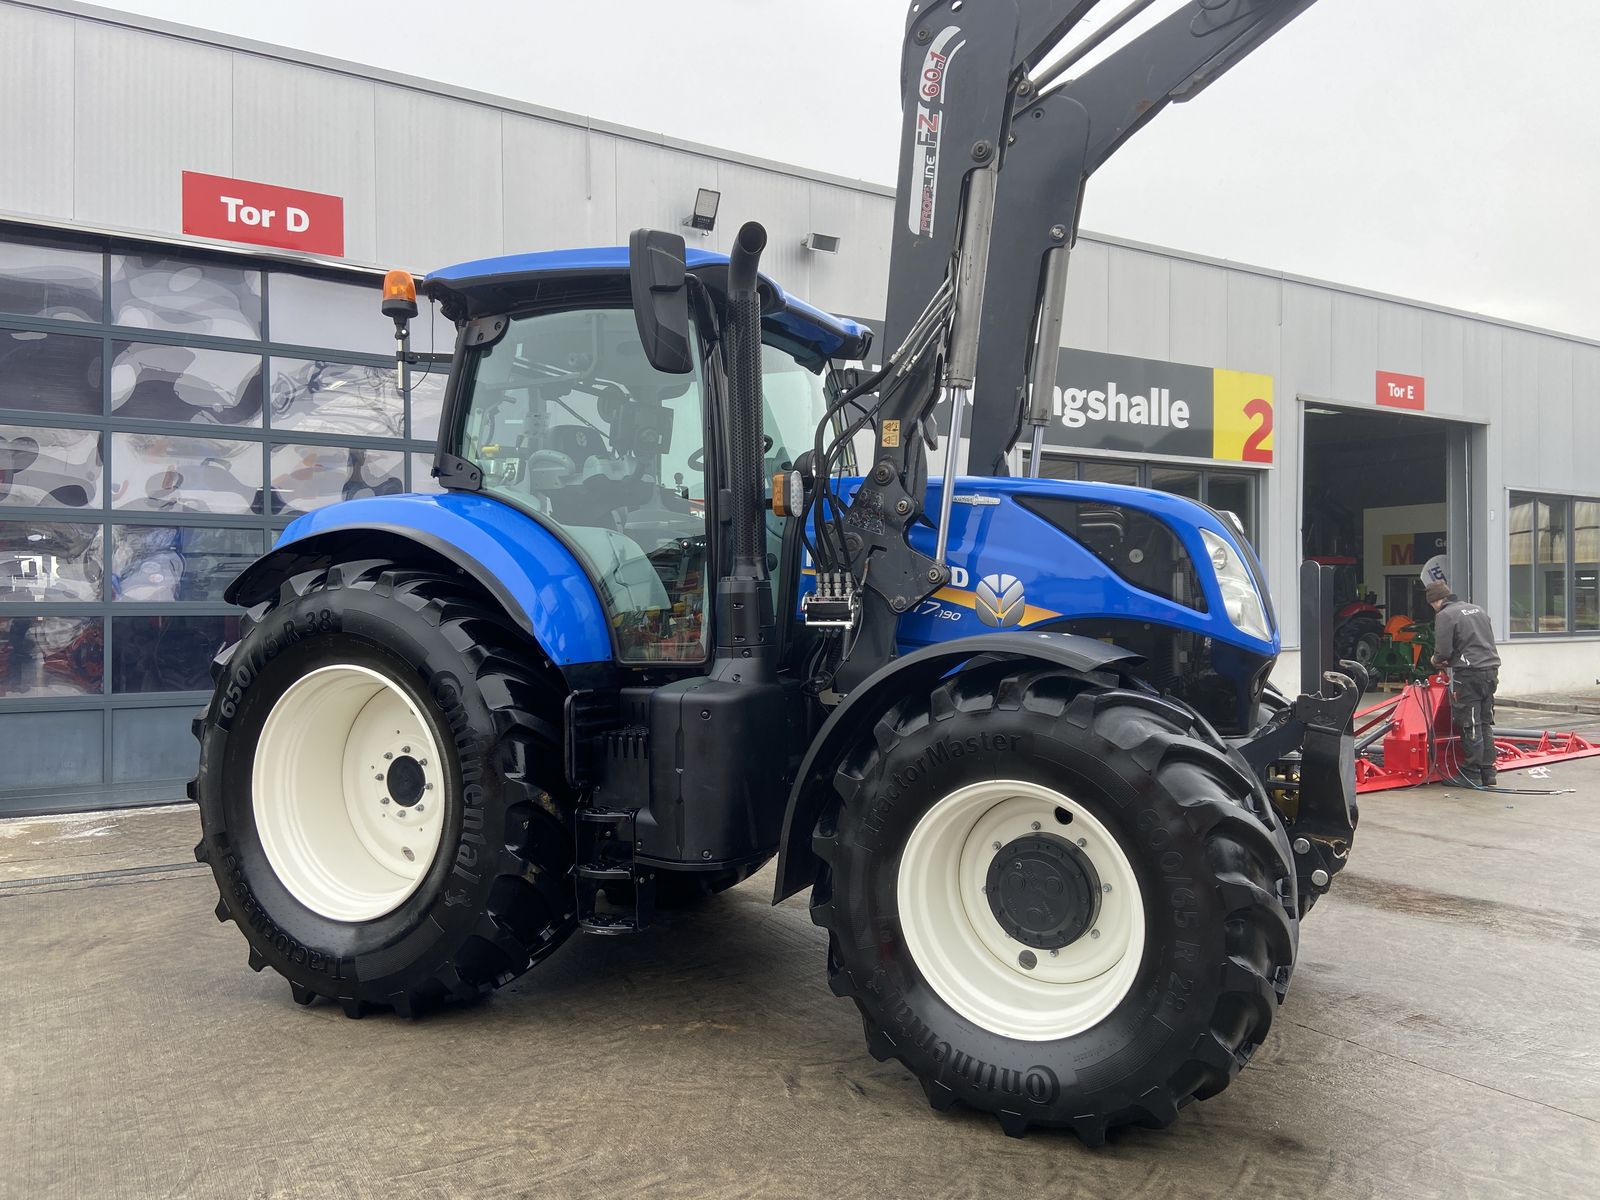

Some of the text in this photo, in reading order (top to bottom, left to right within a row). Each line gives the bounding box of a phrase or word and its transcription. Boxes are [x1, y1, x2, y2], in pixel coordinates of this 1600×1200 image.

[922, 50, 947, 98] 60.1
[917, 113, 939, 148] FZ
[220, 196, 310, 233] Tor D
[1388, 382, 1415, 400] Tor E
[1242, 398, 1273, 463] 2
[305, 608, 334, 634] 38
[430, 671, 487, 884] Continental
[864, 731, 1022, 834] TractorMaster
[880, 988, 1061, 1104] Continental
